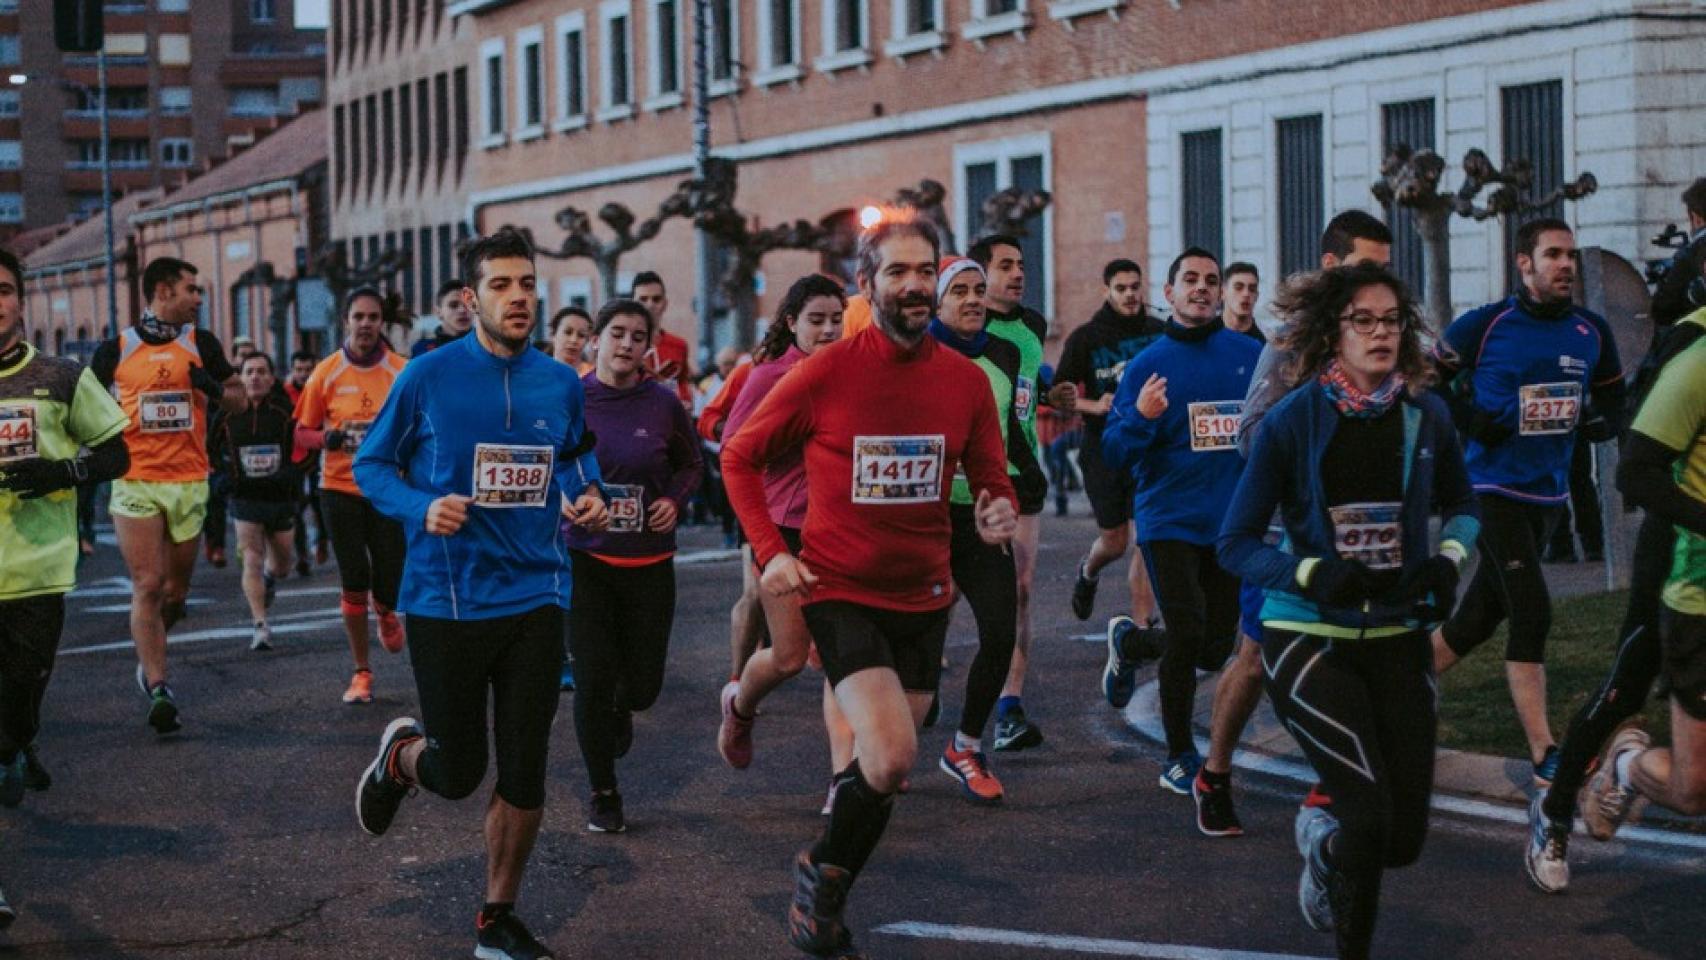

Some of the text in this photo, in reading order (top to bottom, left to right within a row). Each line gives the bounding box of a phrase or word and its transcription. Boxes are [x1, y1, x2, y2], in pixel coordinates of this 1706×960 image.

[156, 405, 177, 417] 80
[1527, 400, 1576, 417] 2372
[1197, 418, 1241, 434] 510
[486, 467, 542, 487] 1388
[867, 460, 932, 480] 1417
[612, 500, 636, 516] 15
